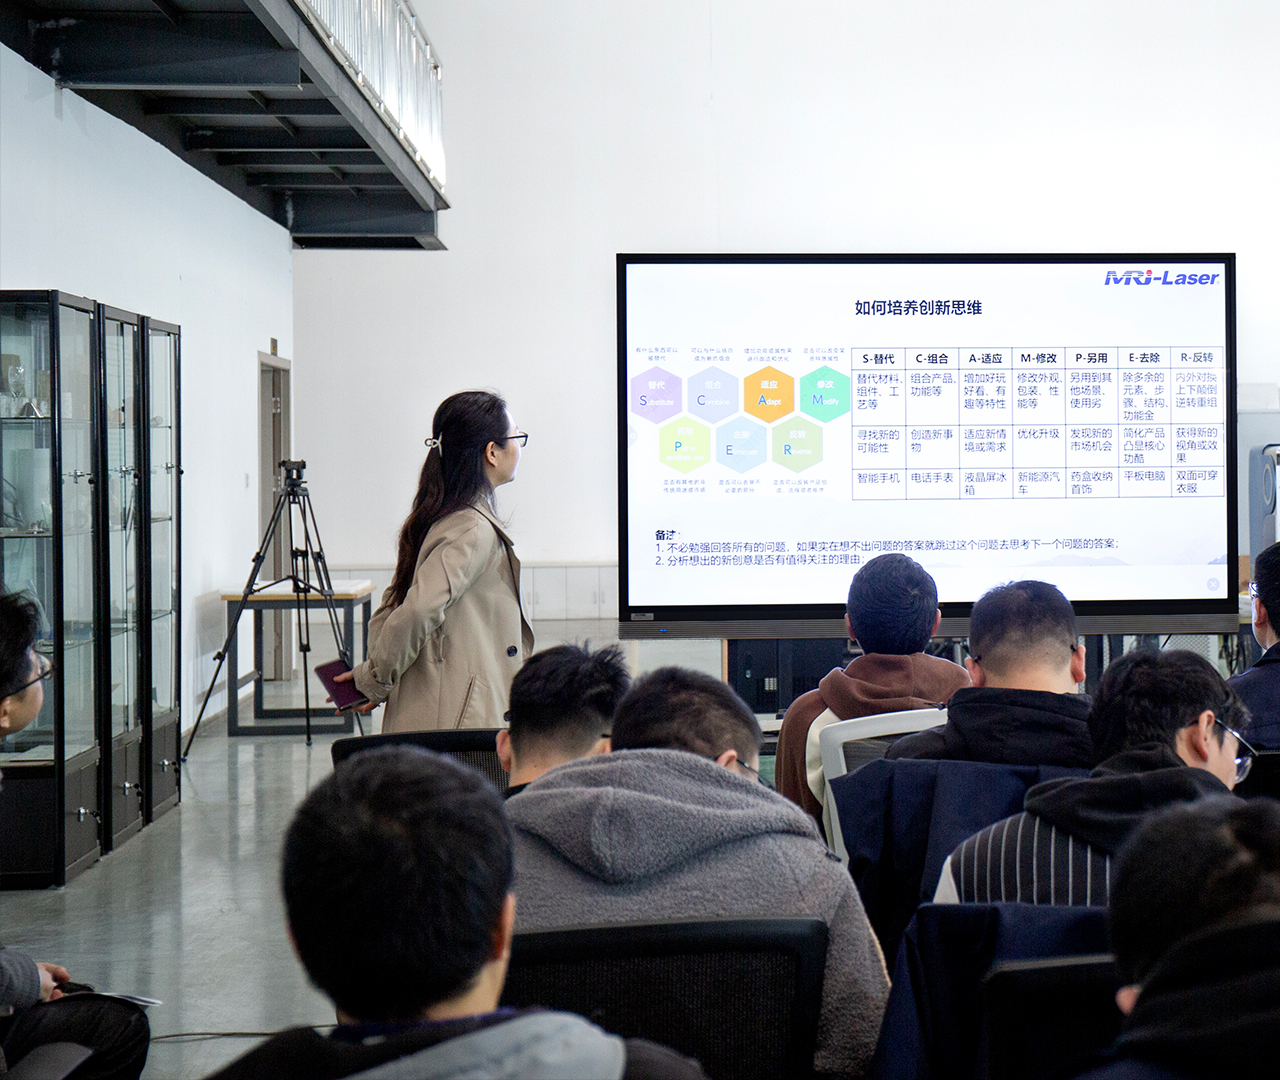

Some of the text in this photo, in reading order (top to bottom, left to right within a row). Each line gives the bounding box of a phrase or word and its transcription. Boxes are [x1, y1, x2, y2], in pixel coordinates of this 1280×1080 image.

[855, 300, 982, 315] 如何培养创新思维
[863, 354, 895, 364] S-替代
[916, 354, 948, 364] C-组合
[969, 354, 1002, 363] A-适应
[1021, 353, 1056, 363] M-修改
[1076, 353, 1107, 363] P-另用
[1130, 353, 1160, 363] E-去除
[1181, 352, 1213, 362] R-反转
[858, 430, 899, 440] 寻找新的
[911, 429, 953, 440] 创造新事
[965, 429, 1006, 439] 适应新情
[1018, 429, 1059, 439] 优化升级
[1071, 428, 1112, 438] 发现新的
[1124, 428, 1165, 438] 简化产品
[1176, 428, 1217, 438] 获得新的
[858, 443, 888, 453] 可能性
[911, 443, 921, 452] 物
[965, 442, 1006, 452] 境或需求
[1071, 441, 1112, 451] 市场机会
[1124, 441, 1165, 451] 凸显核心
[1177, 440, 1217, 450] 视角或效
[1177, 453, 1186, 462] 果
[858, 473, 900, 483] 智能手机
[912, 473, 953, 483] 电话手表
[966, 473, 1006, 482] 液晶屏冰
[1018, 472, 1060, 482] 新能源汽
[1072, 471, 1112, 481] 药盒收纳
[1125, 471, 1165, 481] 平板电脑
[1177, 470, 1217, 480] 双面可穿
[965, 485, 974, 495] 箱
[1019, 485, 1027, 494] 车
[1072, 484, 1092, 494] 首饰
[1177, 483, 1197, 493] 衣服
[656, 543, 664, 552] 1.
[656, 556, 664, 566] 2.
